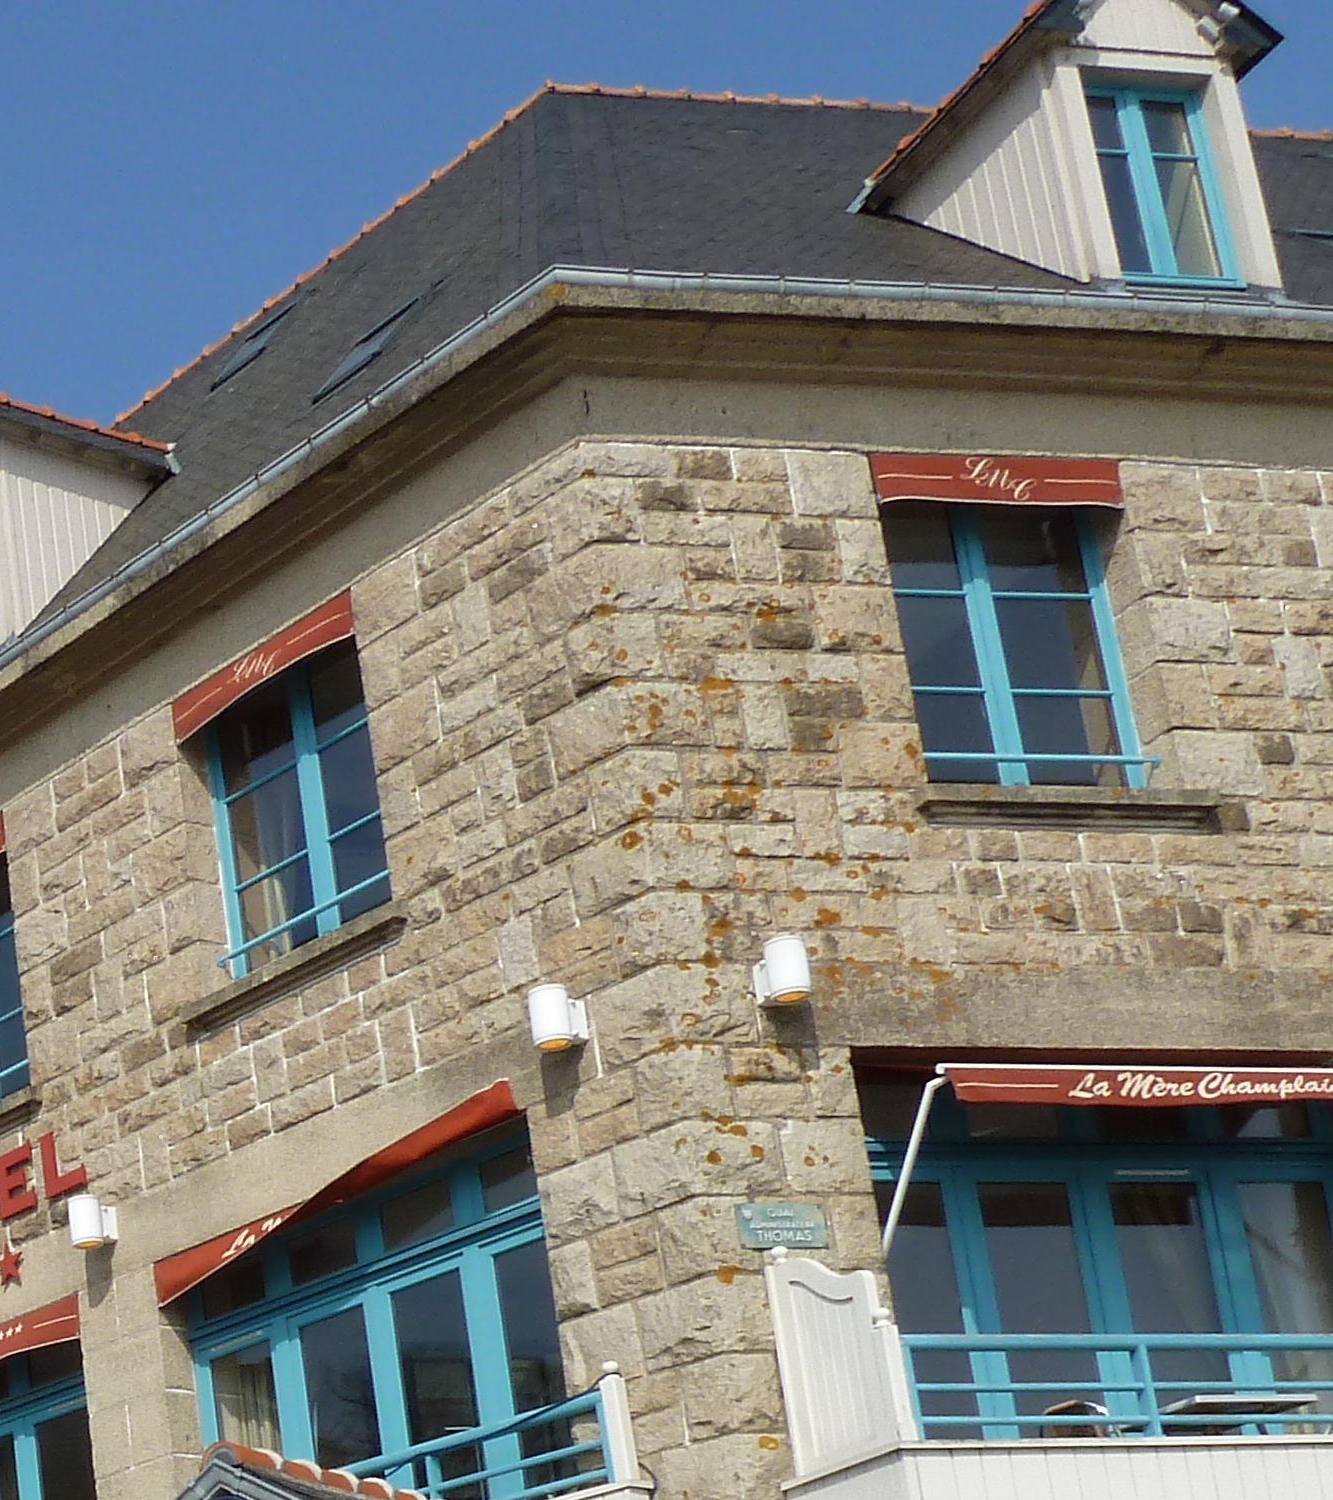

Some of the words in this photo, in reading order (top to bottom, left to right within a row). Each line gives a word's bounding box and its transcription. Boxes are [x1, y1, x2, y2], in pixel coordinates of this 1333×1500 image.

[1068, 1073, 1112, 1099] La
[1117, 1072, 1195, 1099] Mère
[1197, 1072, 1333, 1100] Champlai
[757, 1230, 812, 1242] THOMAS
